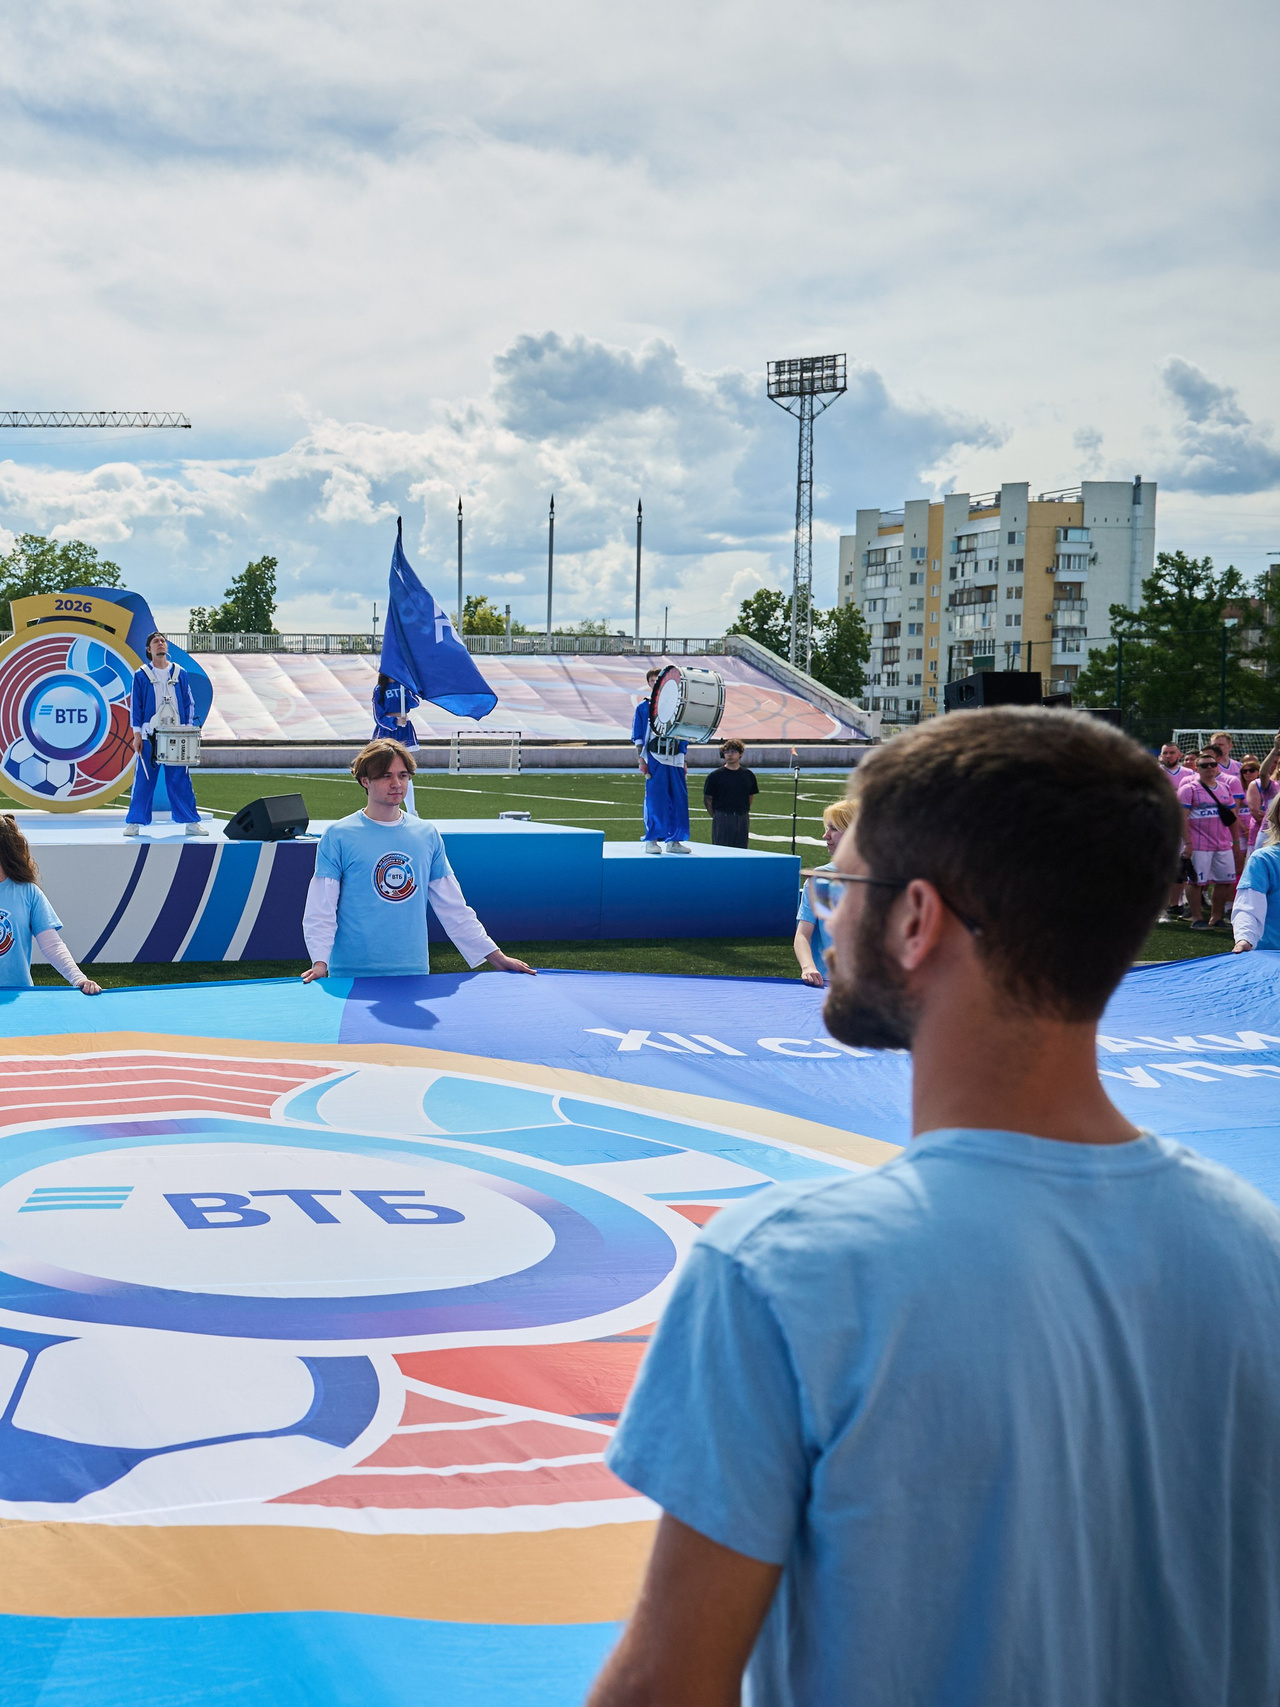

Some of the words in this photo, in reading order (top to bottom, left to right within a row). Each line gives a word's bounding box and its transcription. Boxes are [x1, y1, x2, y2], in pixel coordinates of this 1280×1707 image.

[55, 599, 93, 613] 2026
[386, 688, 402, 699] ВТ
[55, 709, 88, 724] ВТБ
[162, 1189, 466, 1230] ВТБ
